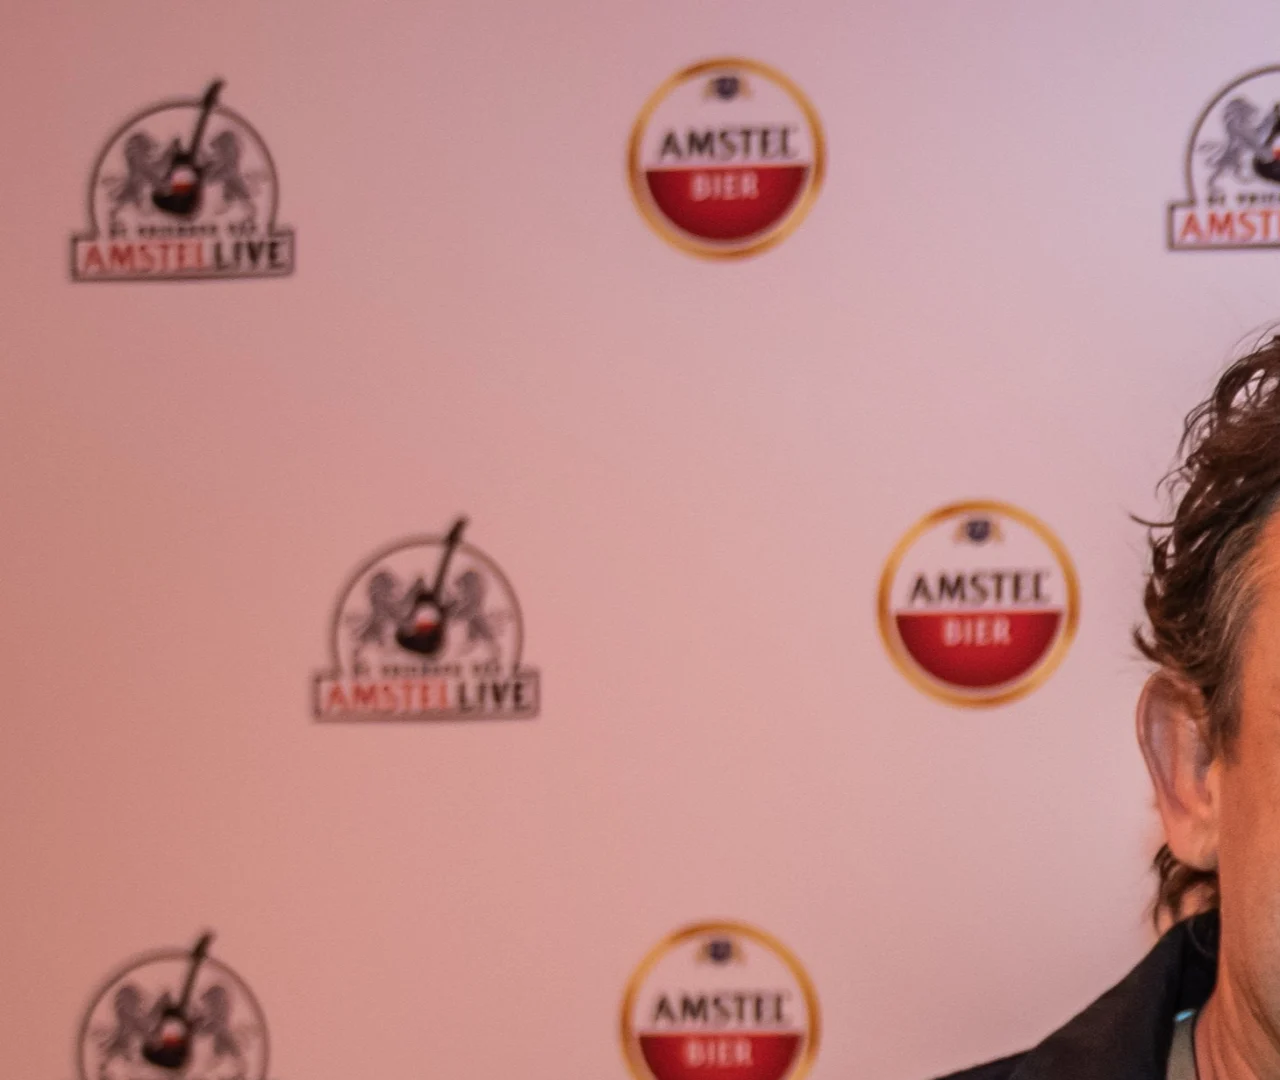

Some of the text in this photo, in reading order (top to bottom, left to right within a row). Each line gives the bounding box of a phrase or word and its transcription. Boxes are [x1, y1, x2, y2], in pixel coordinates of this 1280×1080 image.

[659, 128, 799, 161] AMSTEL
[691, 173, 759, 200] BIER
[909, 572, 1049, 604] AMSTEL
[944, 618, 1011, 647] BIER
[652, 992, 790, 1025] AMSTEL
[685, 1040, 753, 1067] BIER
